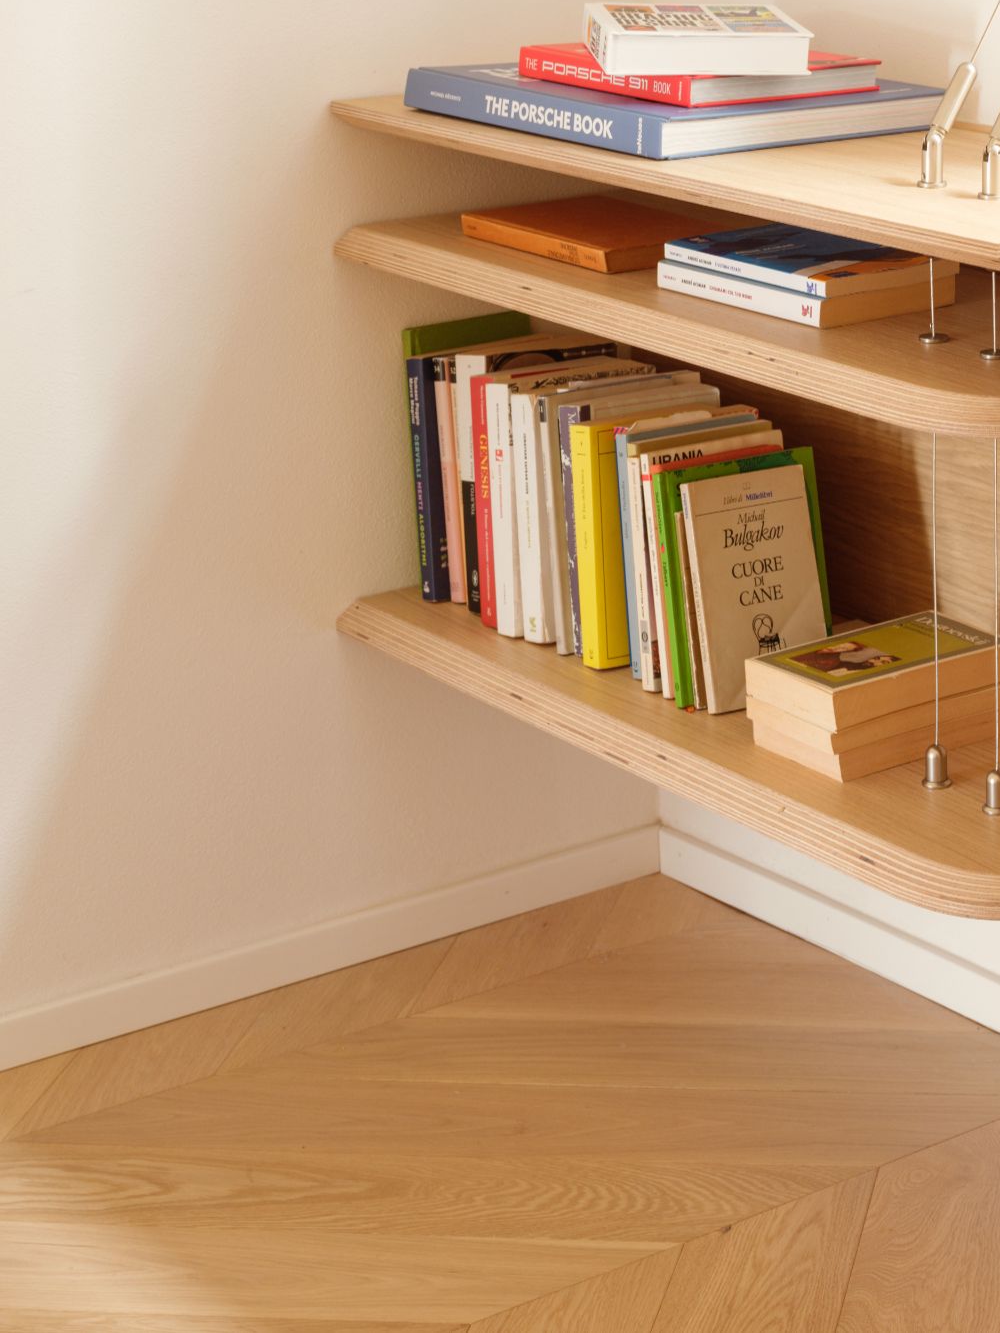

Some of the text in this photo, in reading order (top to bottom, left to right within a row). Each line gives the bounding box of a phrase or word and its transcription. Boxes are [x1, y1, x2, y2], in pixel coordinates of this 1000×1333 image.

[525, 57, 538, 71] THE
[541, 60, 626, 87] PORSCHE
[628, 75, 648, 91] 911
[653, 80, 671, 95] BOOK
[485, 95, 613, 140] THE PORSCHE BOOK
[480, 434, 489, 499] GENESIS
[652, 450, 704, 466] URANIA
[414, 434, 422, 478] CERVELLI
[419, 513, 427, 567] ALGORITMI
[737, 508, 766, 525] Michail
[723, 521, 784, 552] Bulgakov
[731, 556, 784, 580] CUORE
[754, 575, 765, 587] DI
[739, 584, 784, 607] CANE
